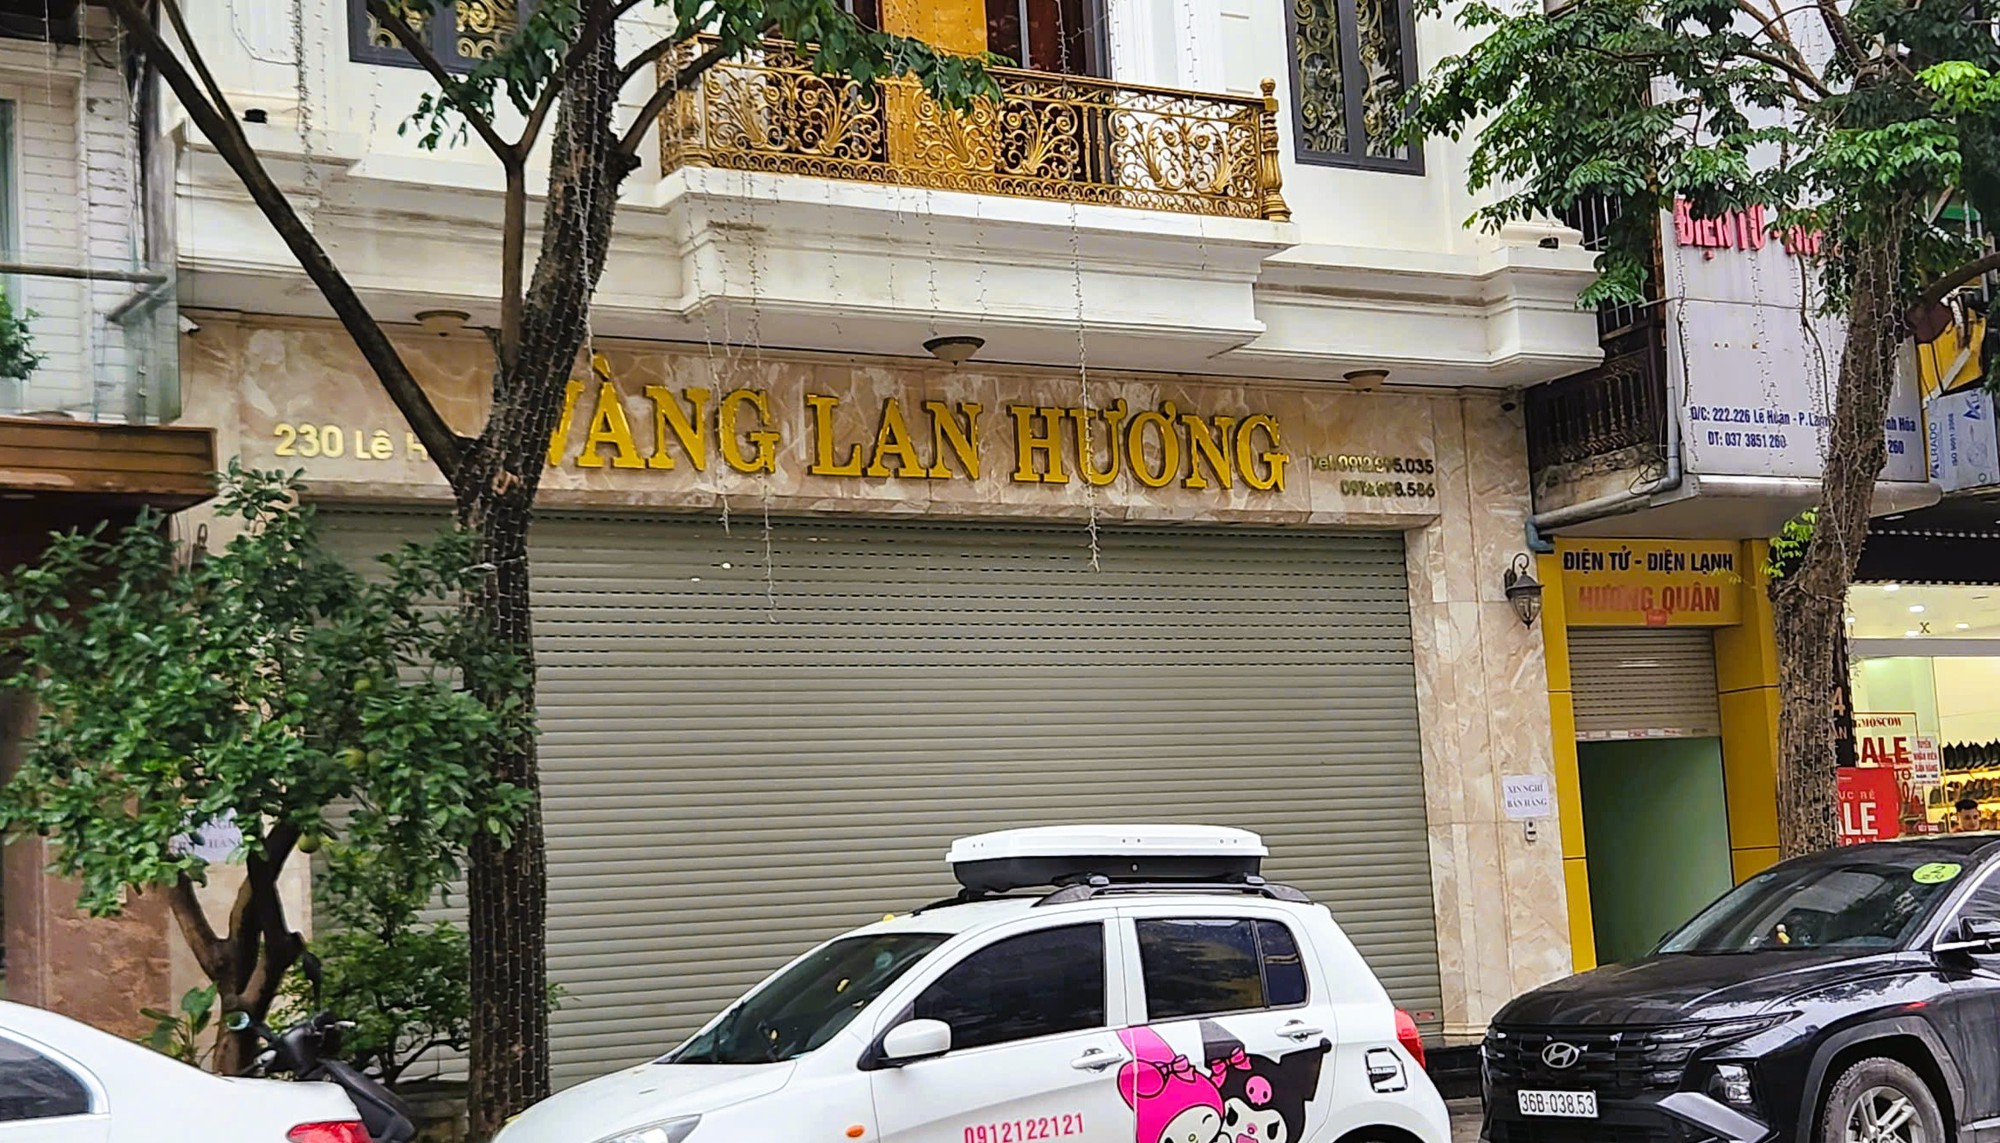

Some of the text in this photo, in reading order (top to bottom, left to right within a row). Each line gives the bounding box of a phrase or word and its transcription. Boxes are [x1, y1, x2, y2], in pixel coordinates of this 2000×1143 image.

[273, 422, 428, 462] 230 Lê H
[806, 393, 983, 481] LAN
[1007, 398, 1289, 492] HƯƠNG
[1725, 432, 1742, 447] 037
[1745, 433, 1767, 448] 3851
[1563, 547, 1604, 574] ĐIỆN
[1647, 548, 1685, 575] ĐIỆN
[1690, 552, 1733, 575] LẠNH
[1661, 581, 1720, 615] QUÂN
[1861, 736, 1911, 764] ALE
[1520, 1092, 1595, 1115] 36B-038.53
[964, 1112, 1083, 1143] 0912122121
